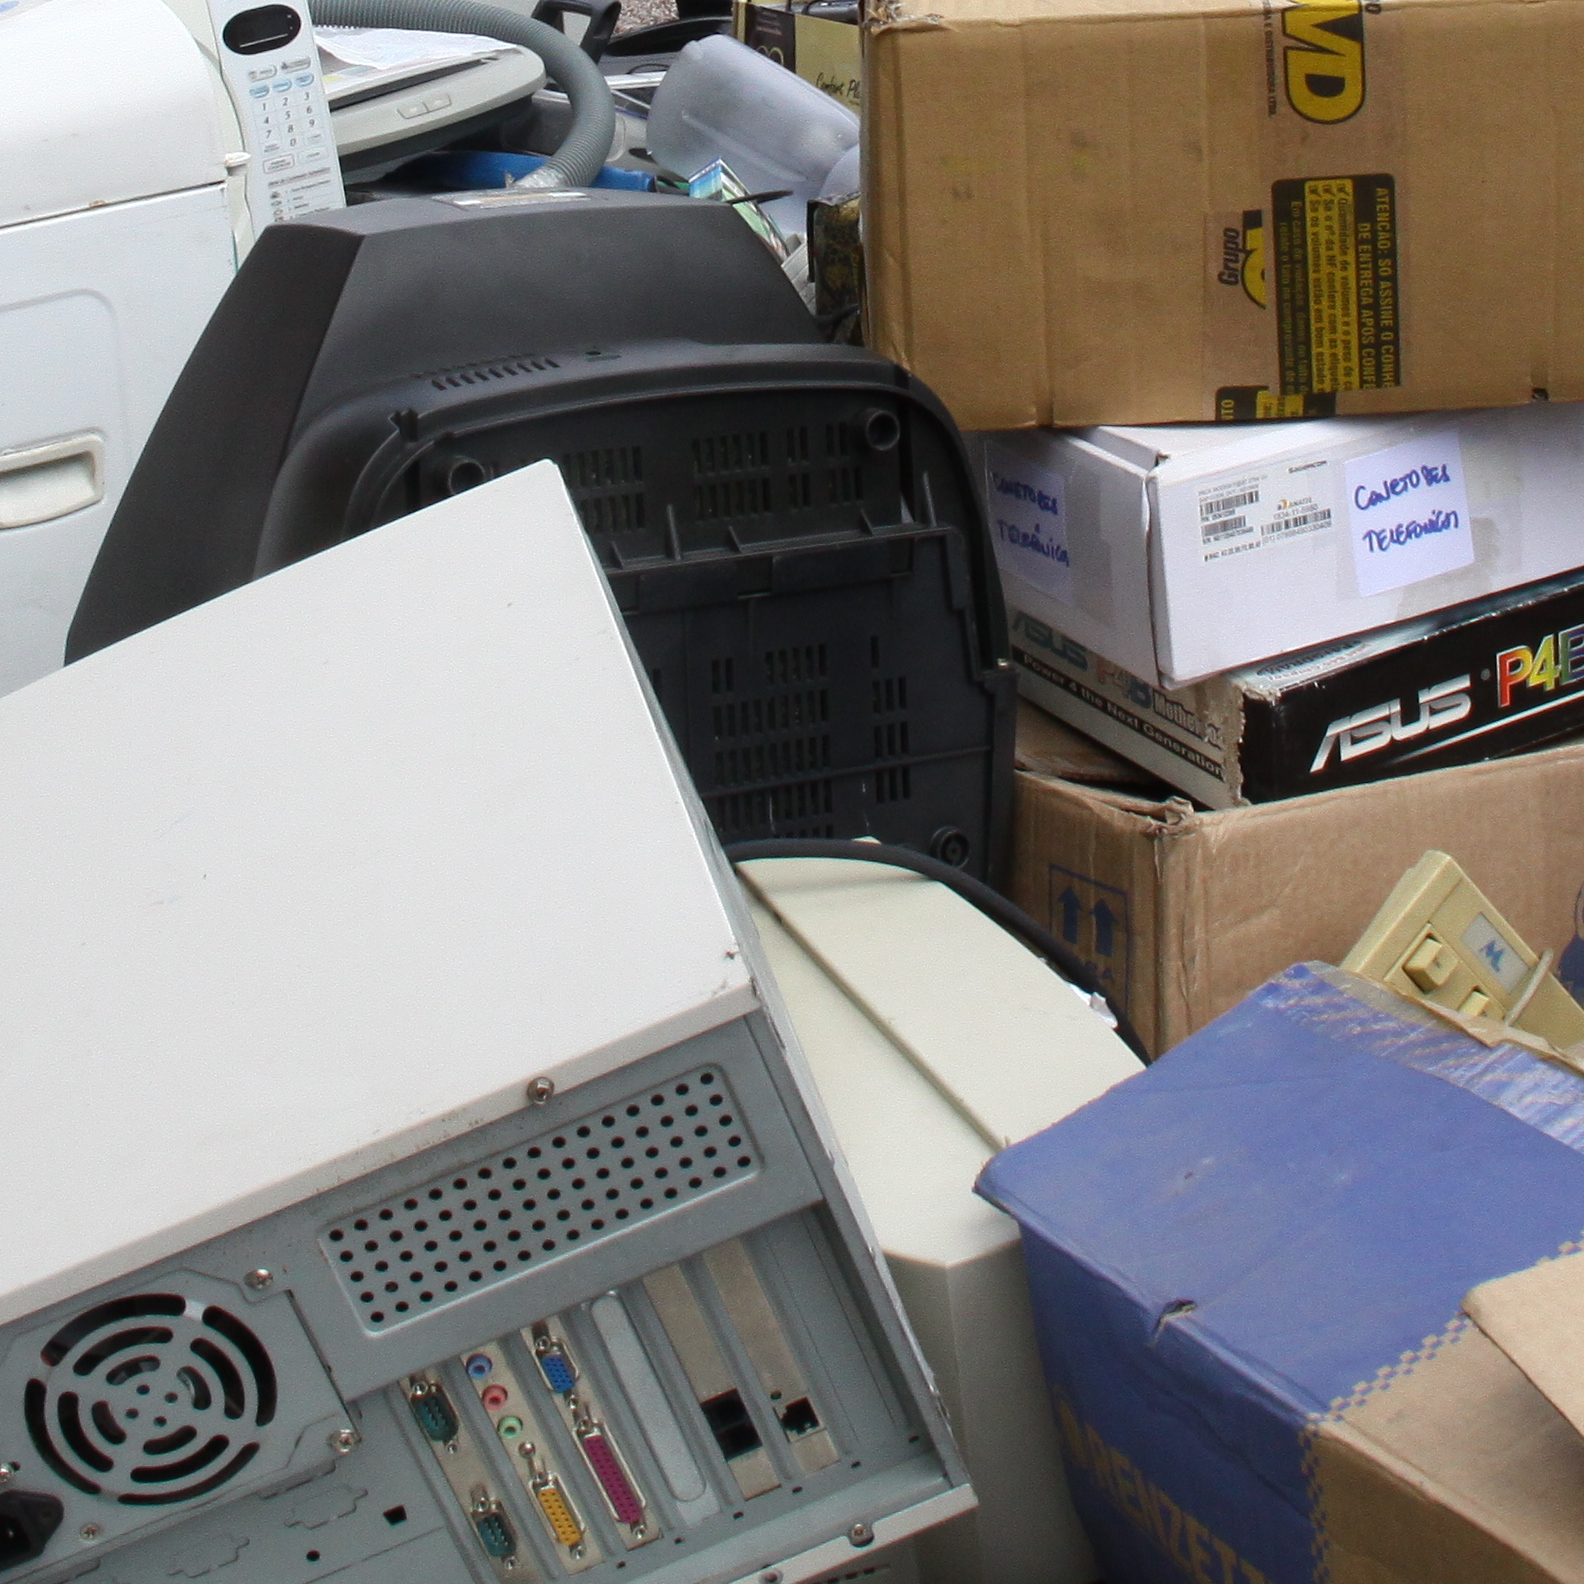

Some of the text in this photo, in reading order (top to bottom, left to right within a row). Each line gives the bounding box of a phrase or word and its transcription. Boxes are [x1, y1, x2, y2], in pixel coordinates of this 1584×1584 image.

[1217, 227, 1246, 286] Grupo
[1358, 222, 1373, 241] DE
[1358, 244, 1374, 300] ENTREGA
[1379, 281, 1394, 327] ASSINE
[1024, 653, 1064, 686] Power
[1080, 686, 1103, 708] the
[1106, 702, 1140, 730] Next
[1142, 721, 1225, 779] Generation
[1310, 673, 1472, 774] ASUS
